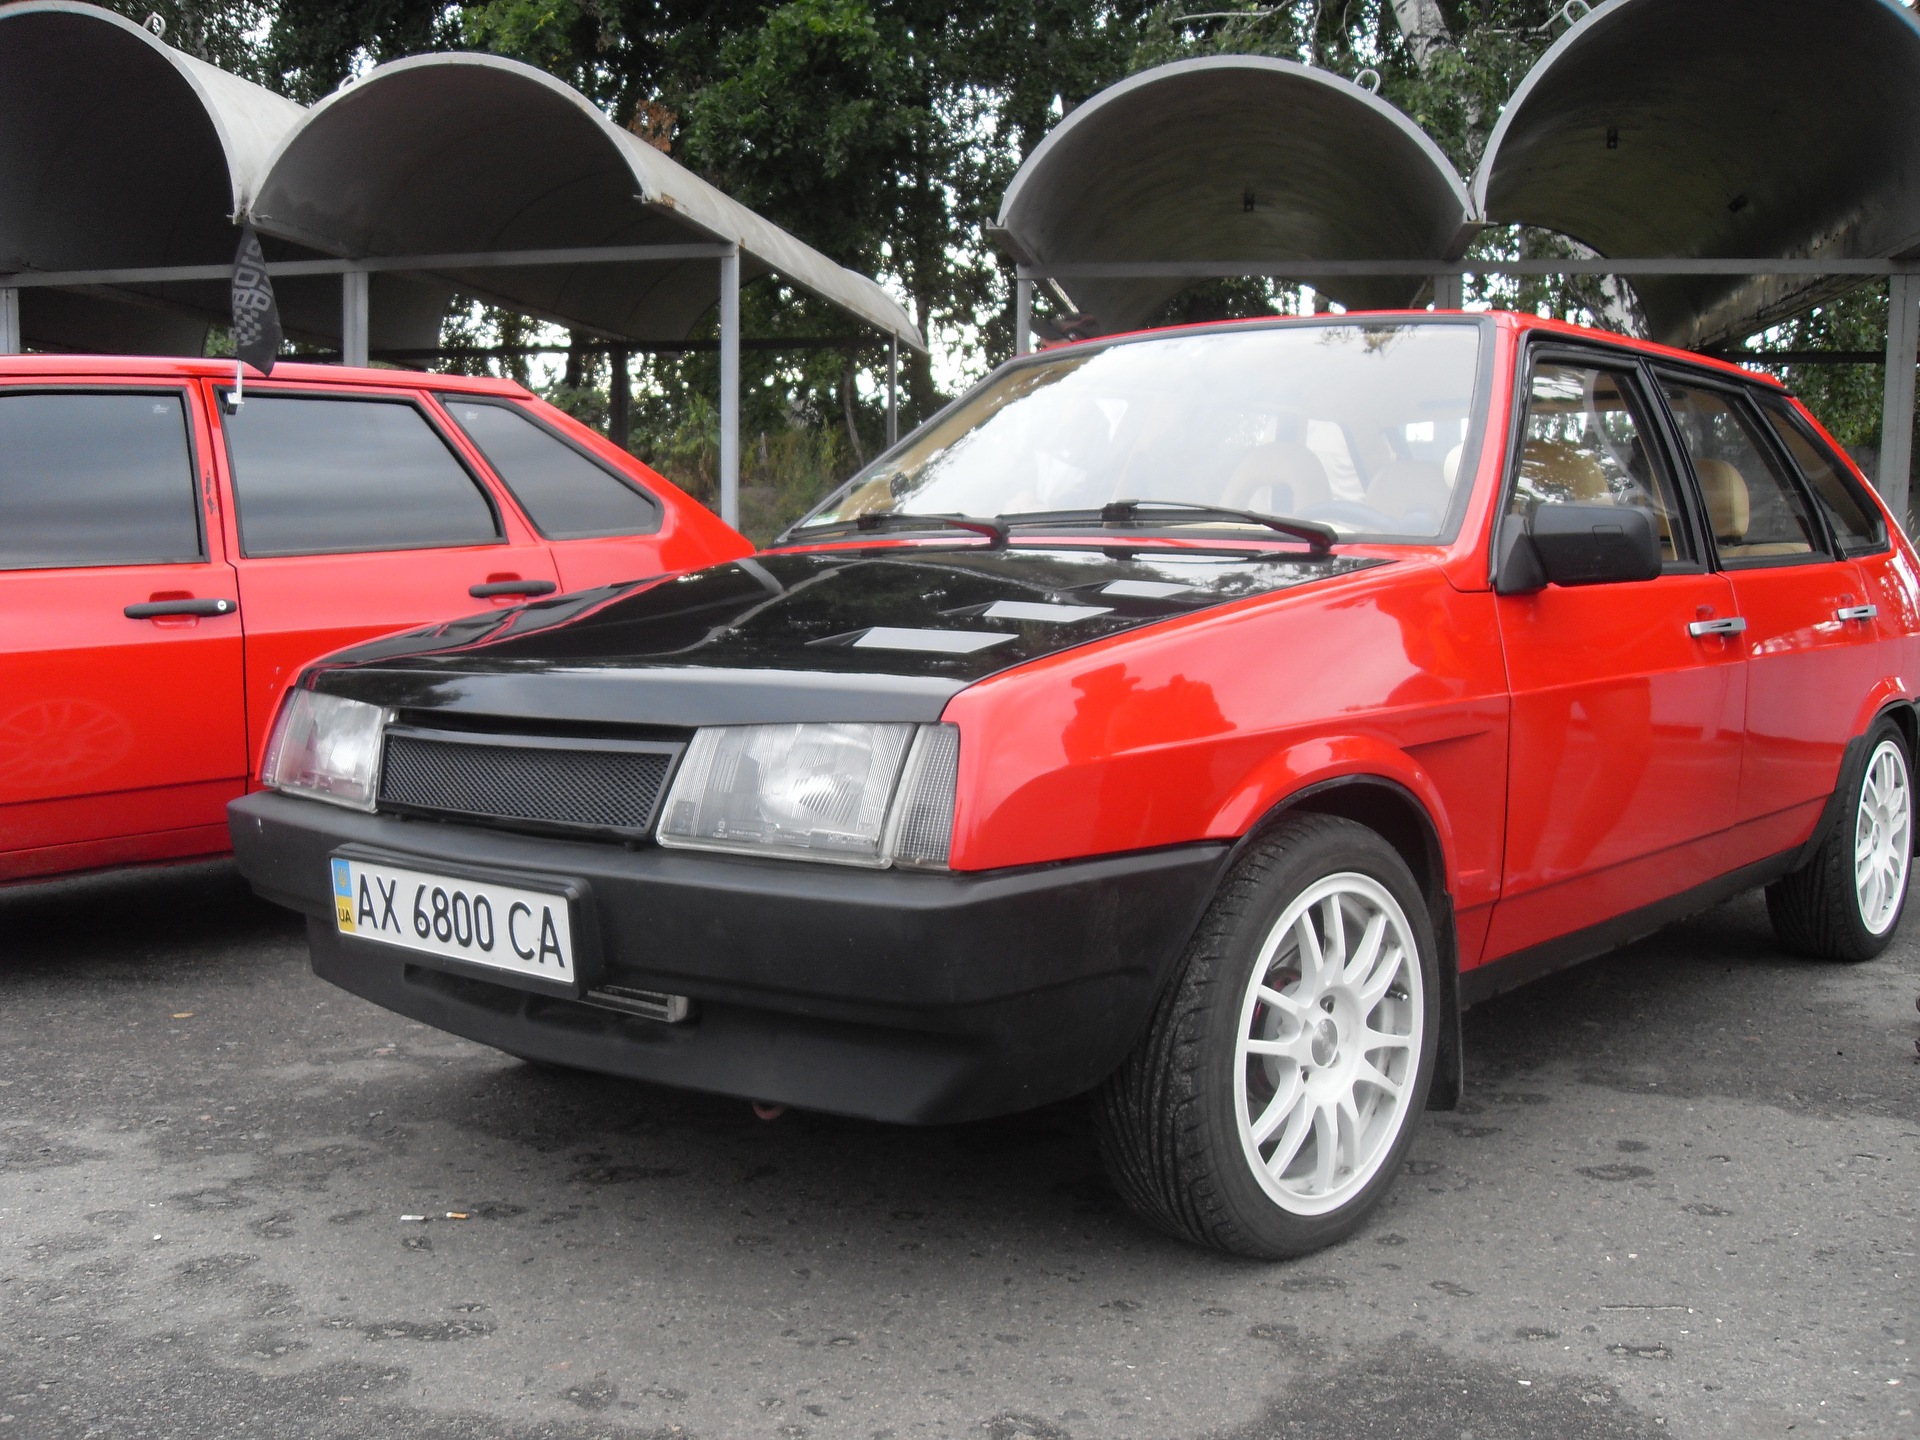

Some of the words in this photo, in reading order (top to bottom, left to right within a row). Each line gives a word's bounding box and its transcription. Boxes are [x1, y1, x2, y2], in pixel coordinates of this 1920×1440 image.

[337, 907, 353, 924] UA
[357, 873, 401, 934] AX
[413, 883, 495, 952] 6800
[508, 901, 565, 968] CA
